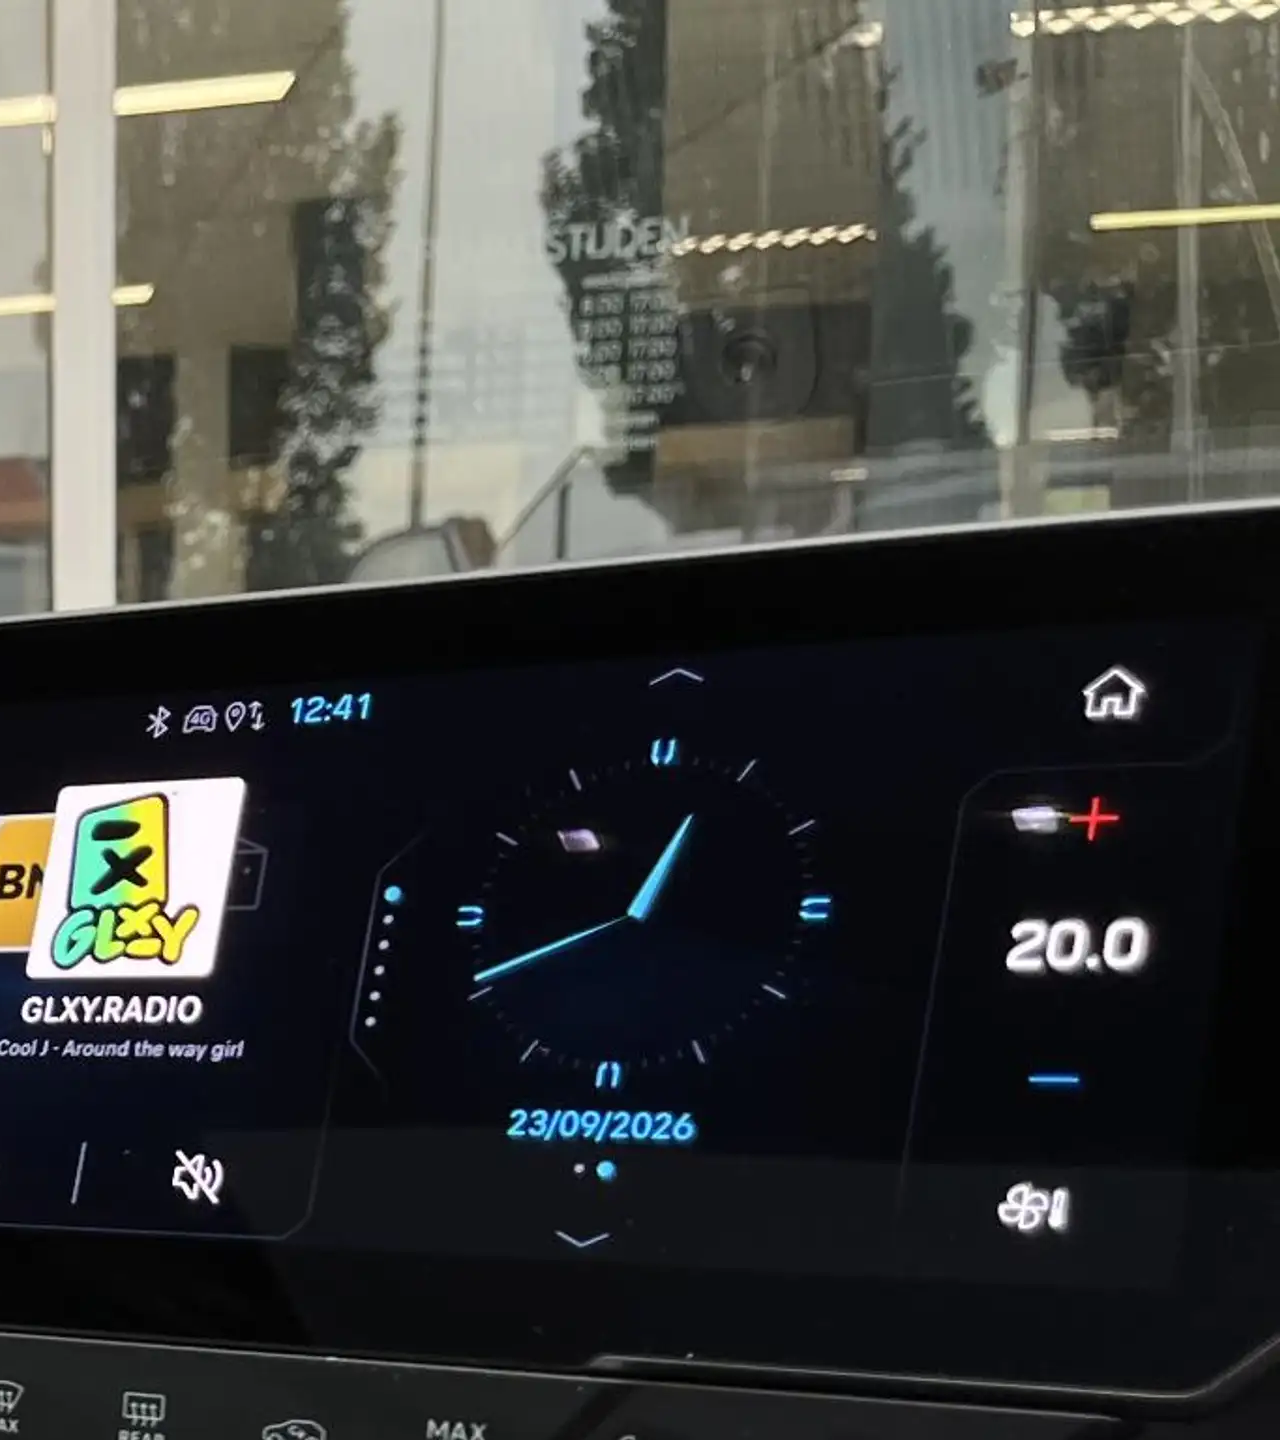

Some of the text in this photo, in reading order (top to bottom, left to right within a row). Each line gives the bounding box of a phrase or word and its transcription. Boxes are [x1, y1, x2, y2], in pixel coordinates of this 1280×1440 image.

[290, 692, 373, 725] 12:41
[1005, 916, 1150, 974] 20.0
[20, 995, 203, 1025] GLXY.RADIO
[61, 1038, 131, 1058] Around
[133, 1039, 164, 1058] the
[167, 1043, 209, 1063] way
[209, 1039, 245, 1063] girl
[507, 1107, 698, 1144] 23/09/2026
